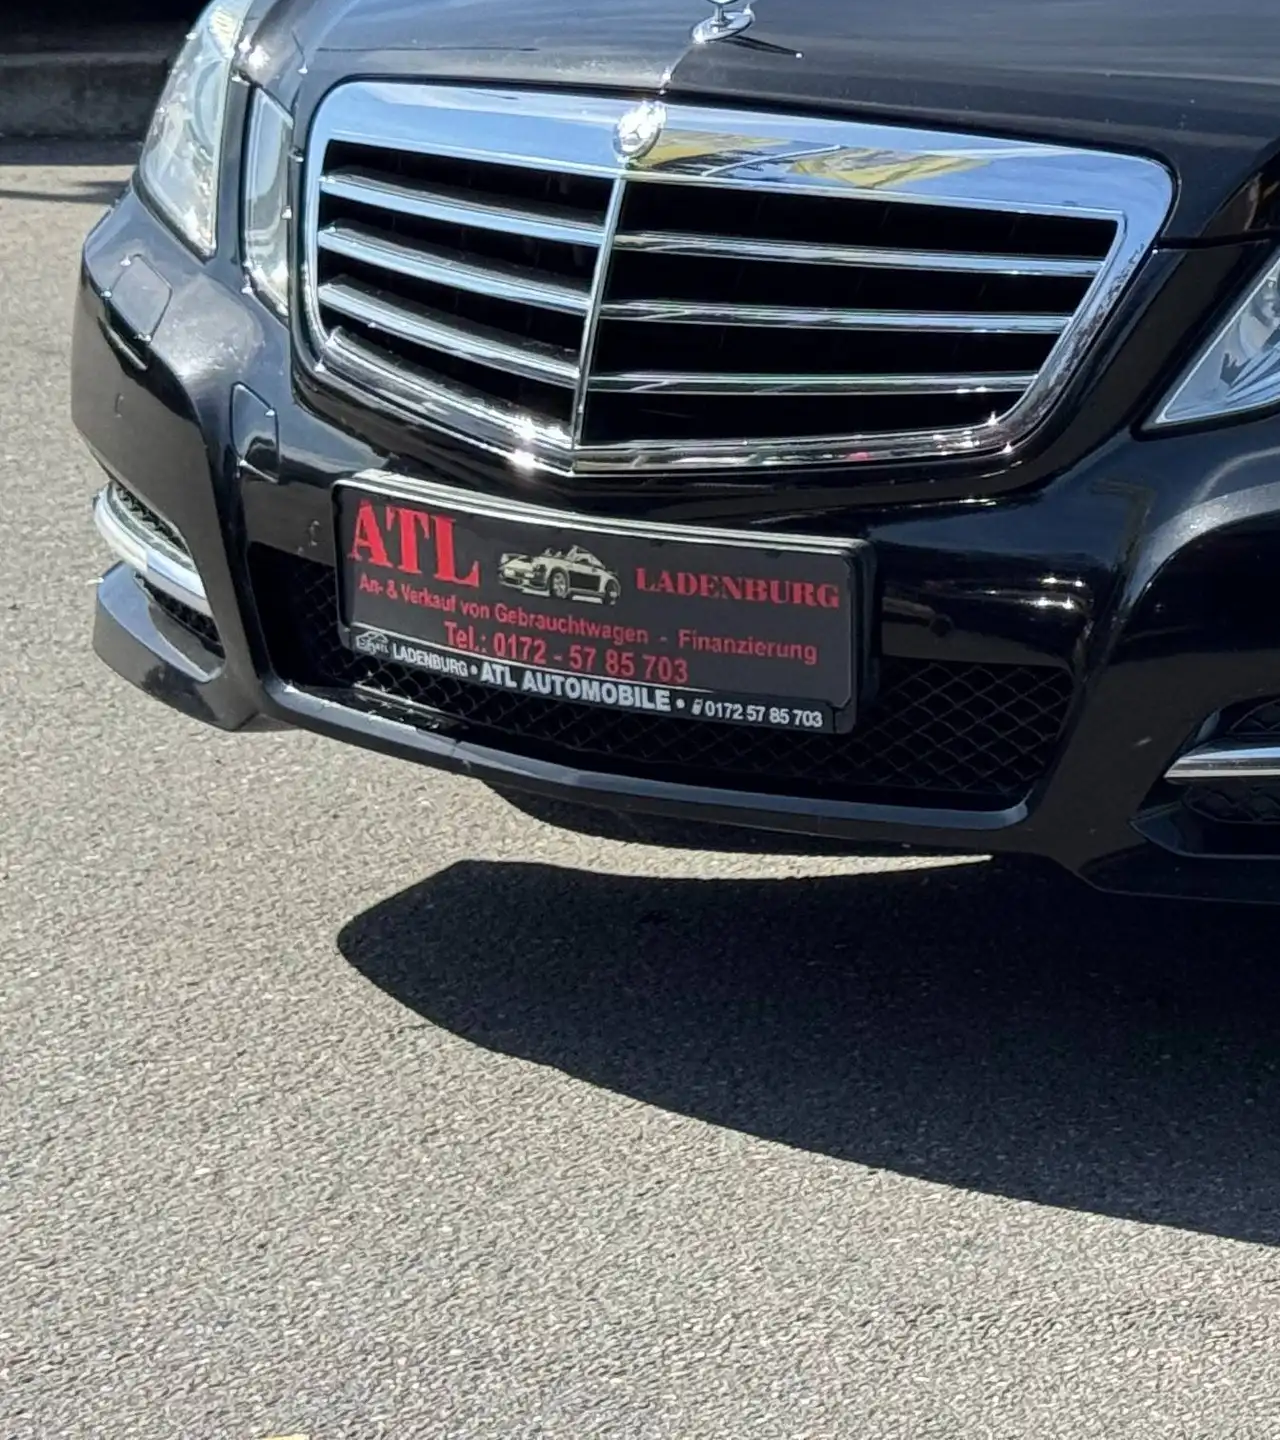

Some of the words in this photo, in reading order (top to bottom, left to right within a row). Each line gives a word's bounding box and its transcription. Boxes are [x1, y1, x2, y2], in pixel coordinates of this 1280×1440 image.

[348, 498, 480, 588] ATL
[359, 574, 384, 594] An-
[387, 579, 398, 598] &
[401, 583, 457, 613] Verkauf
[460, 602, 490, 620] von
[495, 603, 649, 645] Gebrauchtwagen
[678, 629, 818, 665] Finanzierung
[635, 568, 840, 608] LADENBURG
[392, 643, 469, 677] LADENBURG
[481, 662, 517, 688] ATL
[522, 670, 672, 712] AUTOMOBILE
[705, 699, 744, 721] 0172
[747, 705, 766, 723] 57
[769, 707, 790, 725] 85
[793, 710, 823, 728] 703
[444, 621, 487, 654] Tel.:
[493, 633, 547, 665] 0172
[569, 646, 597, 672] 57
[605, 648, 635, 677] 85
[642, 655, 688, 684] 703
